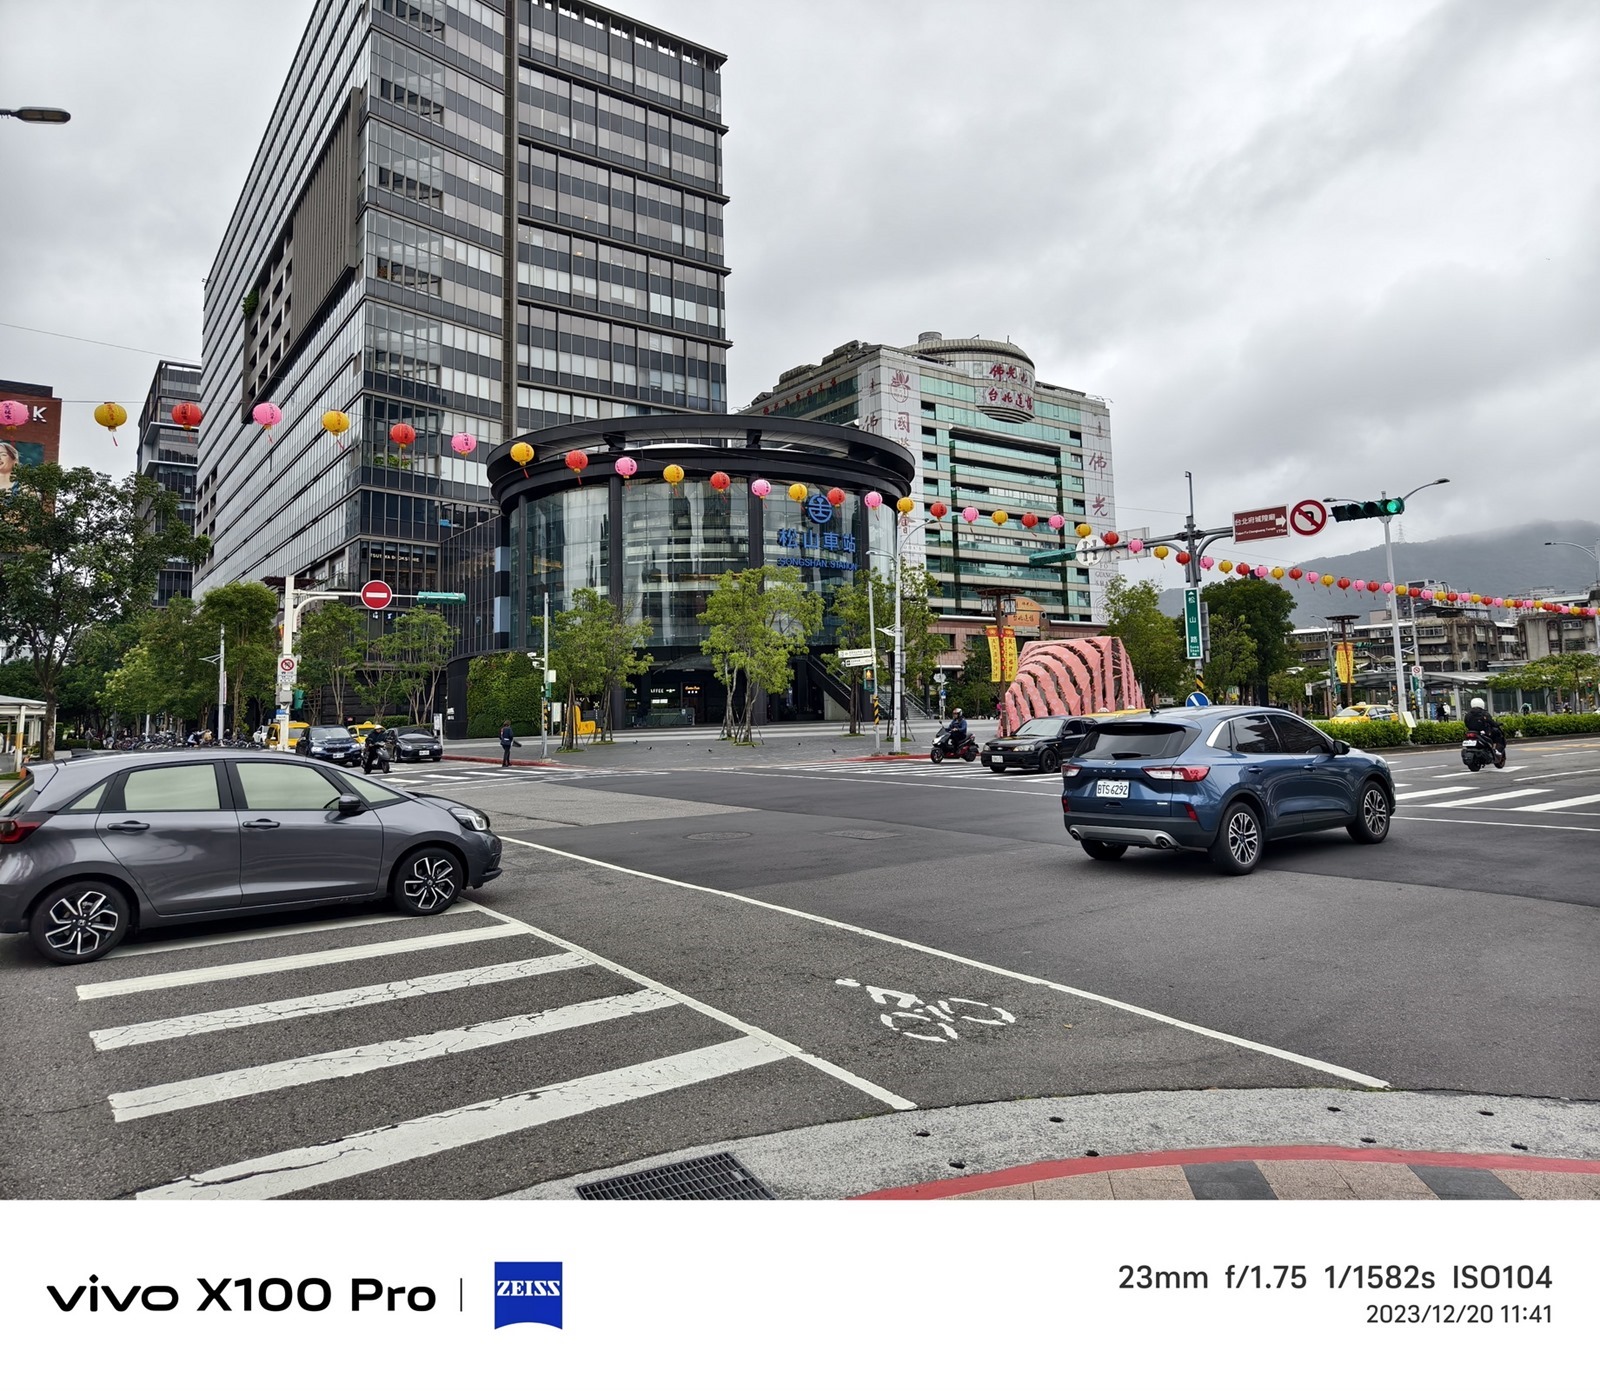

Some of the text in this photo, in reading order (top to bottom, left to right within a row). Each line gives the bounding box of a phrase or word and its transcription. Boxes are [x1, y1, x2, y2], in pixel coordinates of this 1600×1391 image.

[778, 527, 857, 553] 松山車站
[778, 557, 858, 571] SONGSHAN STATION
[1188, 596, 1198, 643] 松山路
